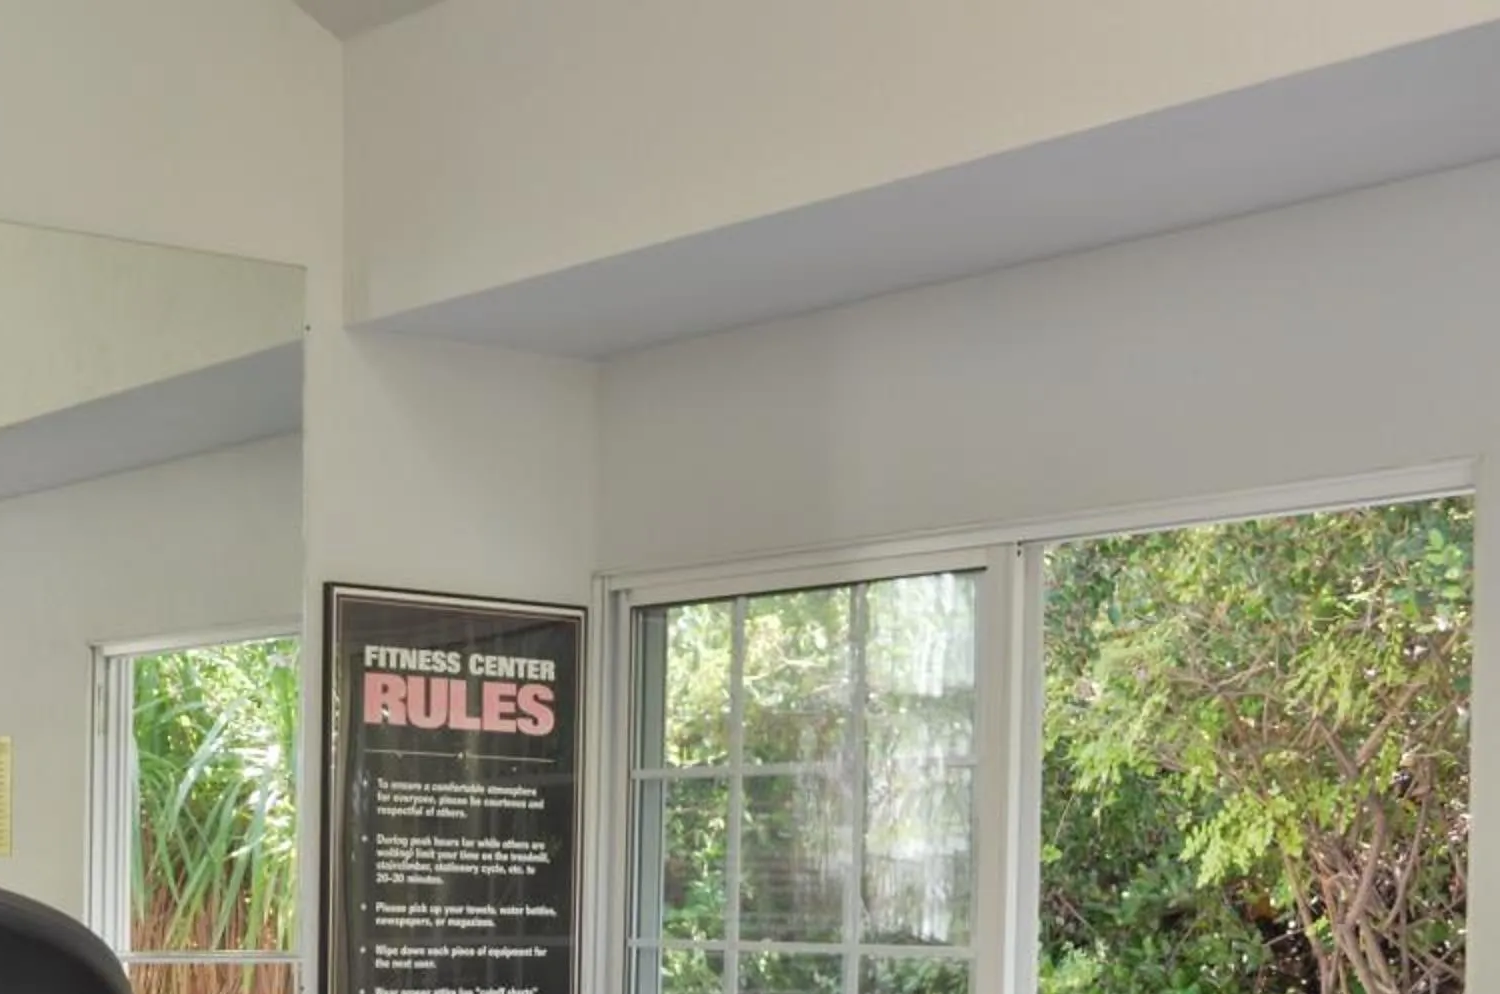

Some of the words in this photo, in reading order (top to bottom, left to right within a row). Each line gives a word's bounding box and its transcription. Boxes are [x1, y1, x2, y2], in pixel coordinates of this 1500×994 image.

[364, 645, 461, 674] FITNESS
[468, 653, 556, 681] CENTER
[363, 672, 555, 736] RULES
[377, 777, 389, 790] To
[432, 782, 485, 793] comfortable
[487, 785, 537, 798] atmosphere
[377, 792, 390, 803] for
[438, 795, 468, 807] please
[470, 795, 481, 807] be
[484, 798, 526, 808] courteous
[528, 798, 544, 809] and
[377, 805, 423, 818] respectful
[426, 807, 435, 816] of
[376, 833, 408, 847] During
[409, 834, 432, 848] peak
[477, 837, 500, 849] while
[502, 838, 529, 850] others
[416, 847, 436, 860] limit
[438, 851, 458, 863] your
[460, 849, 480, 861] time
[495, 850, 508, 862] the
[434, 862, 479, 875] stationary
[526, 865, 536, 876] to
[376, 901, 406, 914] Please
[408, 902, 427, 916] pick
[429, 905, 442, 917] up
[444, 905, 463, 917] your
[499, 906, 524, 917] water
[435, 917, 445, 927] or
[375, 944, 399, 958] Wipe
[400, 945, 425, 957] down
[428, 945, 449, 957] each
[451, 946, 474, 959] piece
[478, 946, 487, 957] of
[488, 947, 532, 959] equipment
[534, 945, 548, 957] for
[375, 958, 390, 969] the
[392, 959, 412, 969] next
